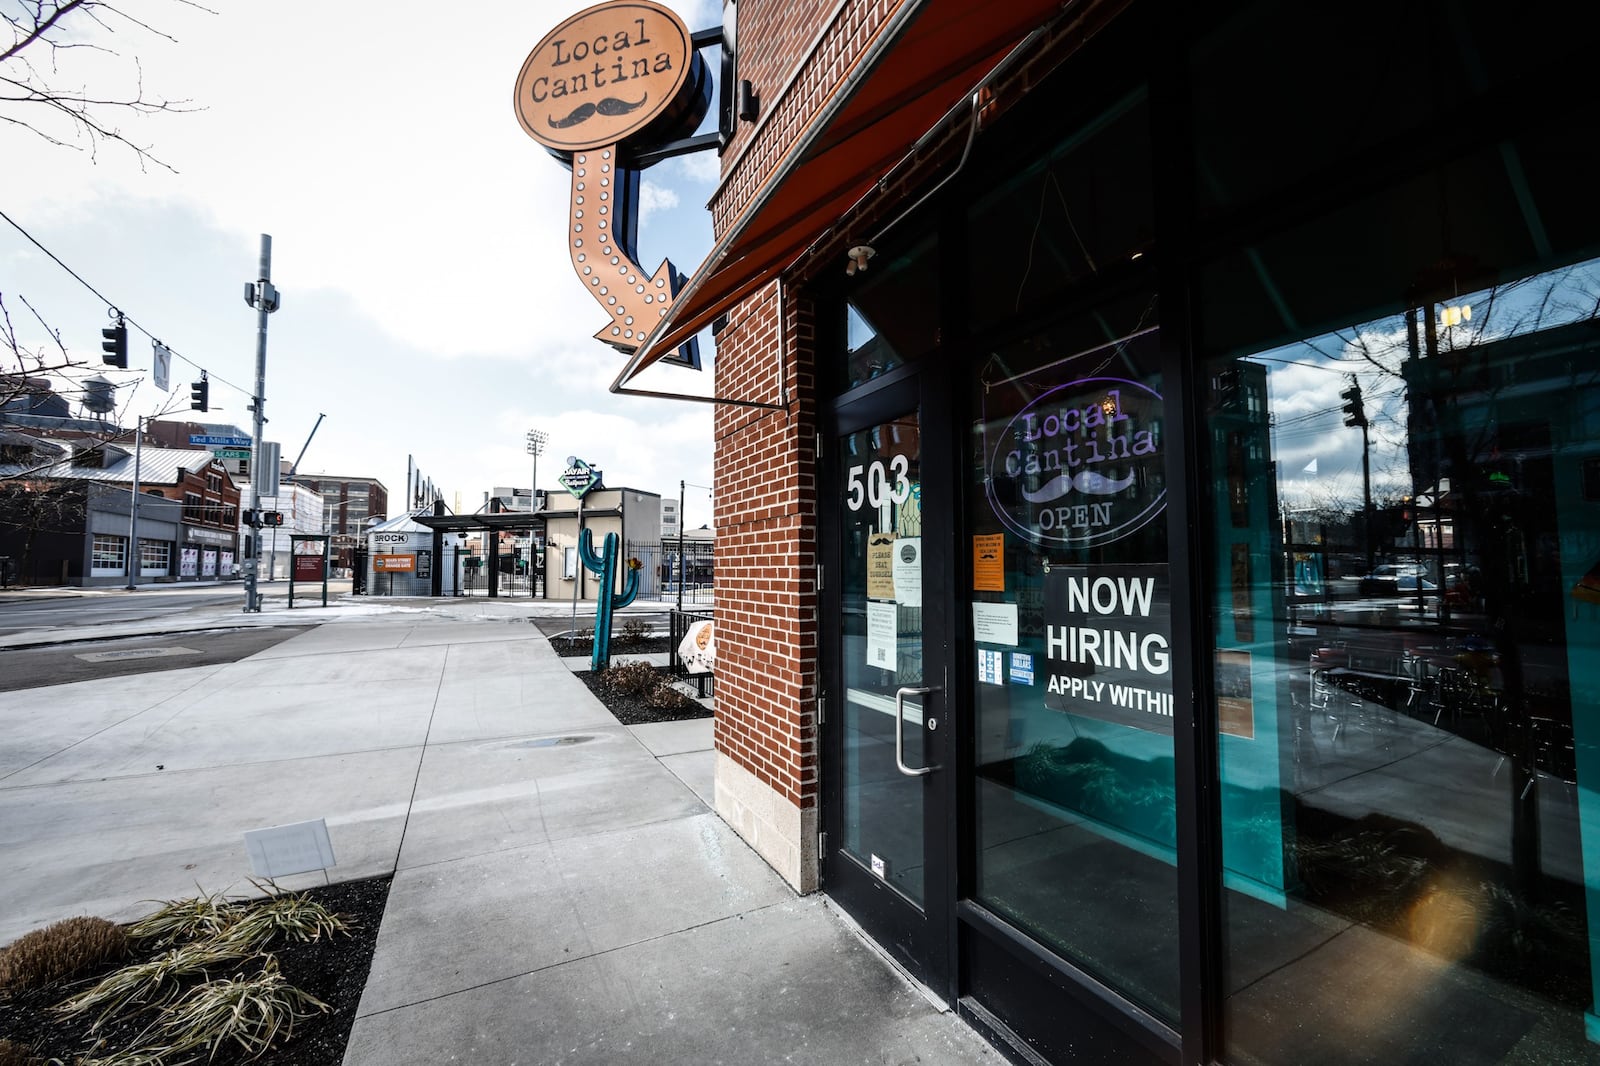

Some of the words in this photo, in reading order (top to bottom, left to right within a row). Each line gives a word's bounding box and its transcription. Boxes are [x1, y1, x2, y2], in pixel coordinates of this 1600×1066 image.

[551, 18, 651, 67] Local
[532, 52, 673, 103] Cantina
[1021, 389, 1129, 443] Local
[210, 436, 229, 444] Mills
[232, 438, 250, 446] Way
[1005, 430, 1157, 478] Cantina
[846, 454, 910, 512] 503
[375, 534, 405, 542] BROCK
[1038, 502, 1114, 531] OPEN
[1068, 576, 1155, 617] NOW
[1046, 625, 1170, 675] HIRING
[1047, 674, 1105, 703] APPLY
[1108, 683, 1174, 717] WITHI
